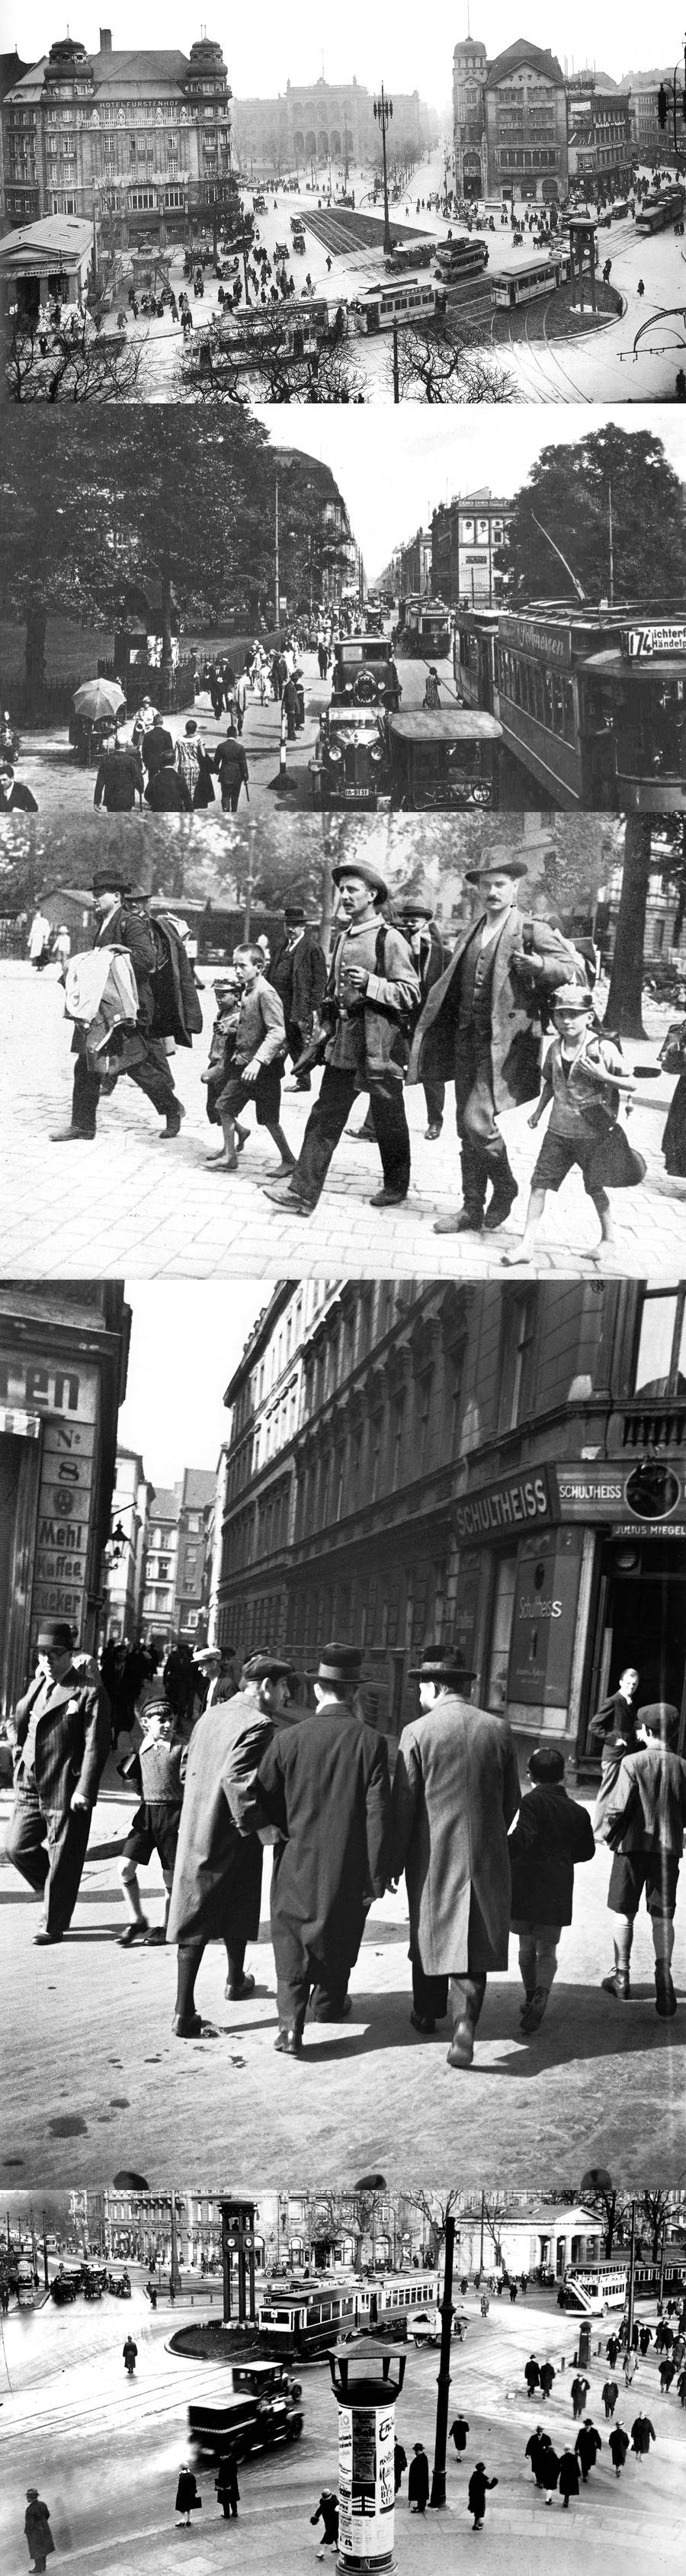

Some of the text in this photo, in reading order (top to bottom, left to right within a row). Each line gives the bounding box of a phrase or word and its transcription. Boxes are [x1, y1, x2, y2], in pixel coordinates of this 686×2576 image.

[652, 628, 686, 638] ichterf
[630, 631, 652, 655] 174
[559, 1485, 621, 1498] SCHULTHEISS
[457, 1479, 547, 1536] SCHULTHEISS
[39, 1521, 82, 1548] Mehl
[615, 1526, 686, 1535] JULIUS MIEGEL
